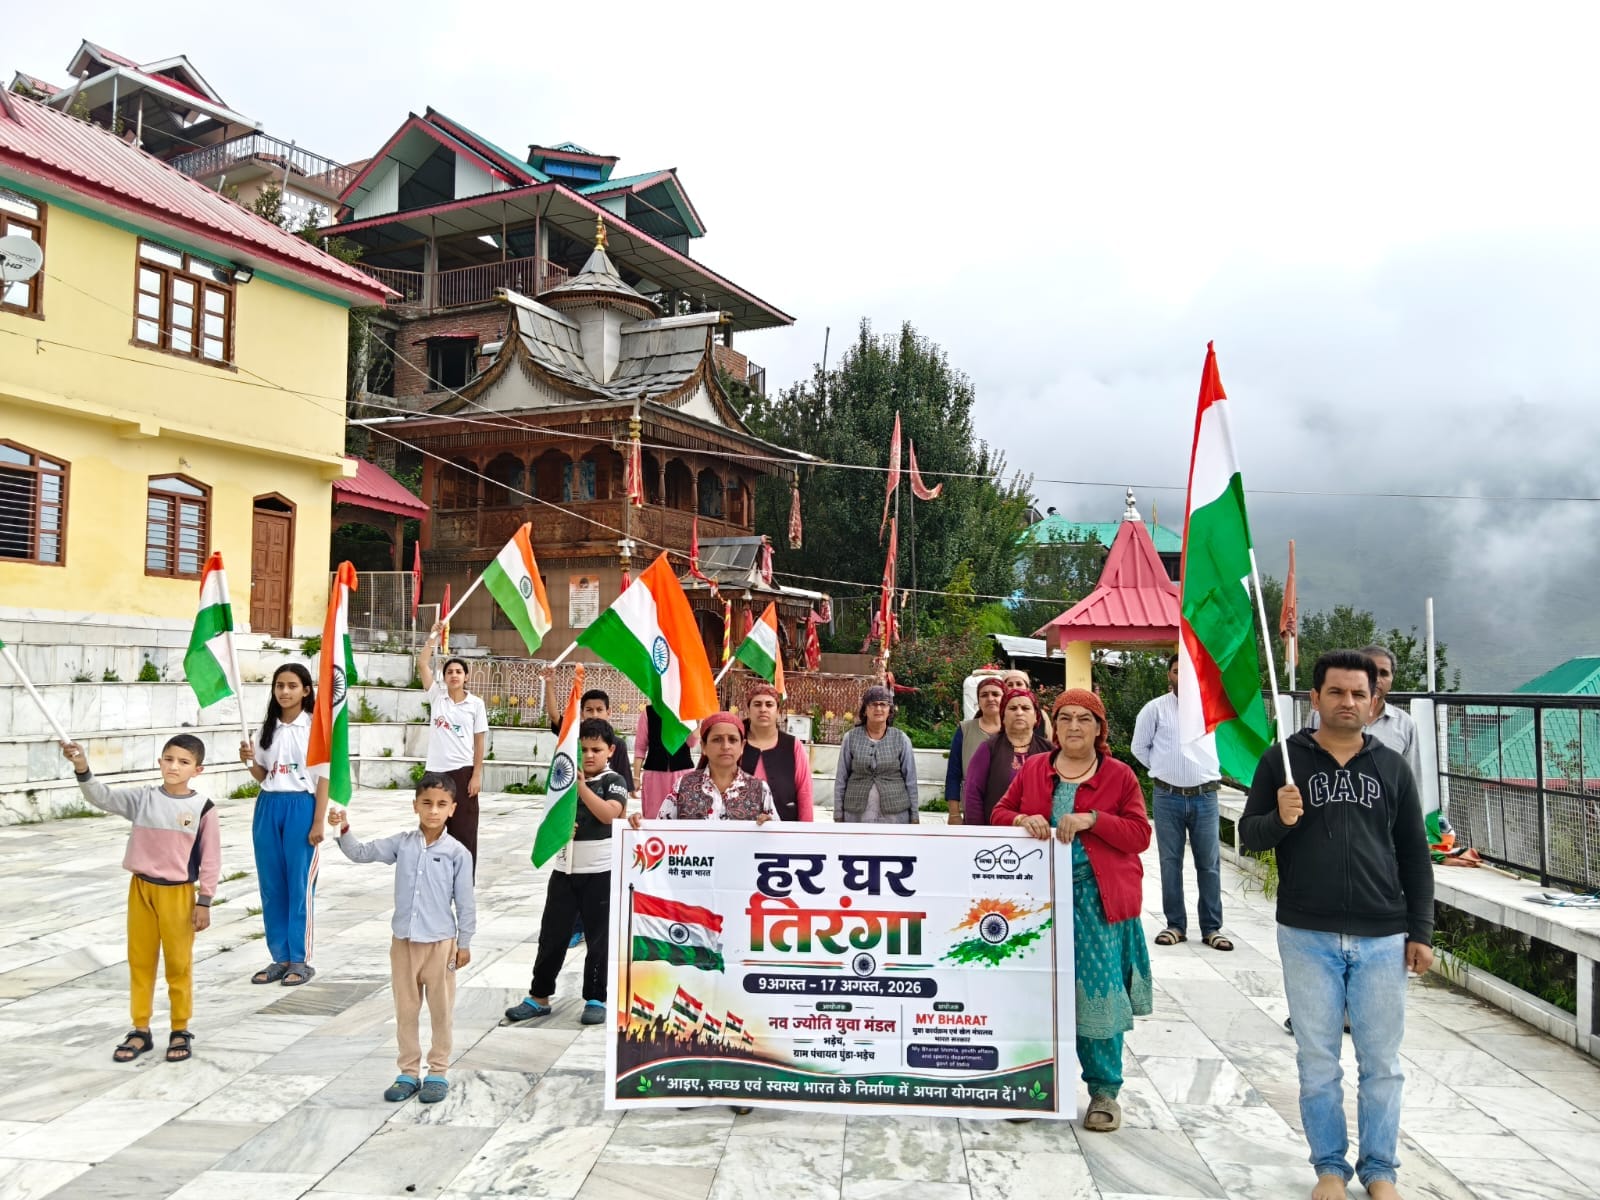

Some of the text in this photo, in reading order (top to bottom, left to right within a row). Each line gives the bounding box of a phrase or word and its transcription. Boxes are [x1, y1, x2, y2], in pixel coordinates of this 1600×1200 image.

[1308, 769, 1380, 808] GAP
[668, 845, 688, 855] MY
[668, 856, 714, 868] BHARAT
[668, 867, 678, 876] मेरी
[681, 869, 693, 878] युवा
[754, 853, 917, 898] हर घर
[745, 892, 926, 955] तिरंगा
[758, 978, 806, 991] 9अगस्त
[820, 979, 834, 991] 17
[840, 980, 884, 993] अगस्त,
[888, 981, 922, 994] 2026
[769, 1014, 896, 1034] नव ज्योति युवा मंडल
[916, 1014, 988, 1025] MY BHARAT
[811, 1048, 837, 1059] पंचायत
[708, 1079, 740, 1091] स्वच्छ
[744, 1077, 762, 1092] एवं
[766, 1080, 799, 1093] स्वस्थ
[804, 1082, 834, 1094] भारत
[839, 1079, 851, 1094] के
[855, 1081, 894, 1096] निर्माण
[899, 1082, 909, 1097] में
[913, 1085, 947, 1098] अपना
[951, 1085, 998, 1100] योगदान
